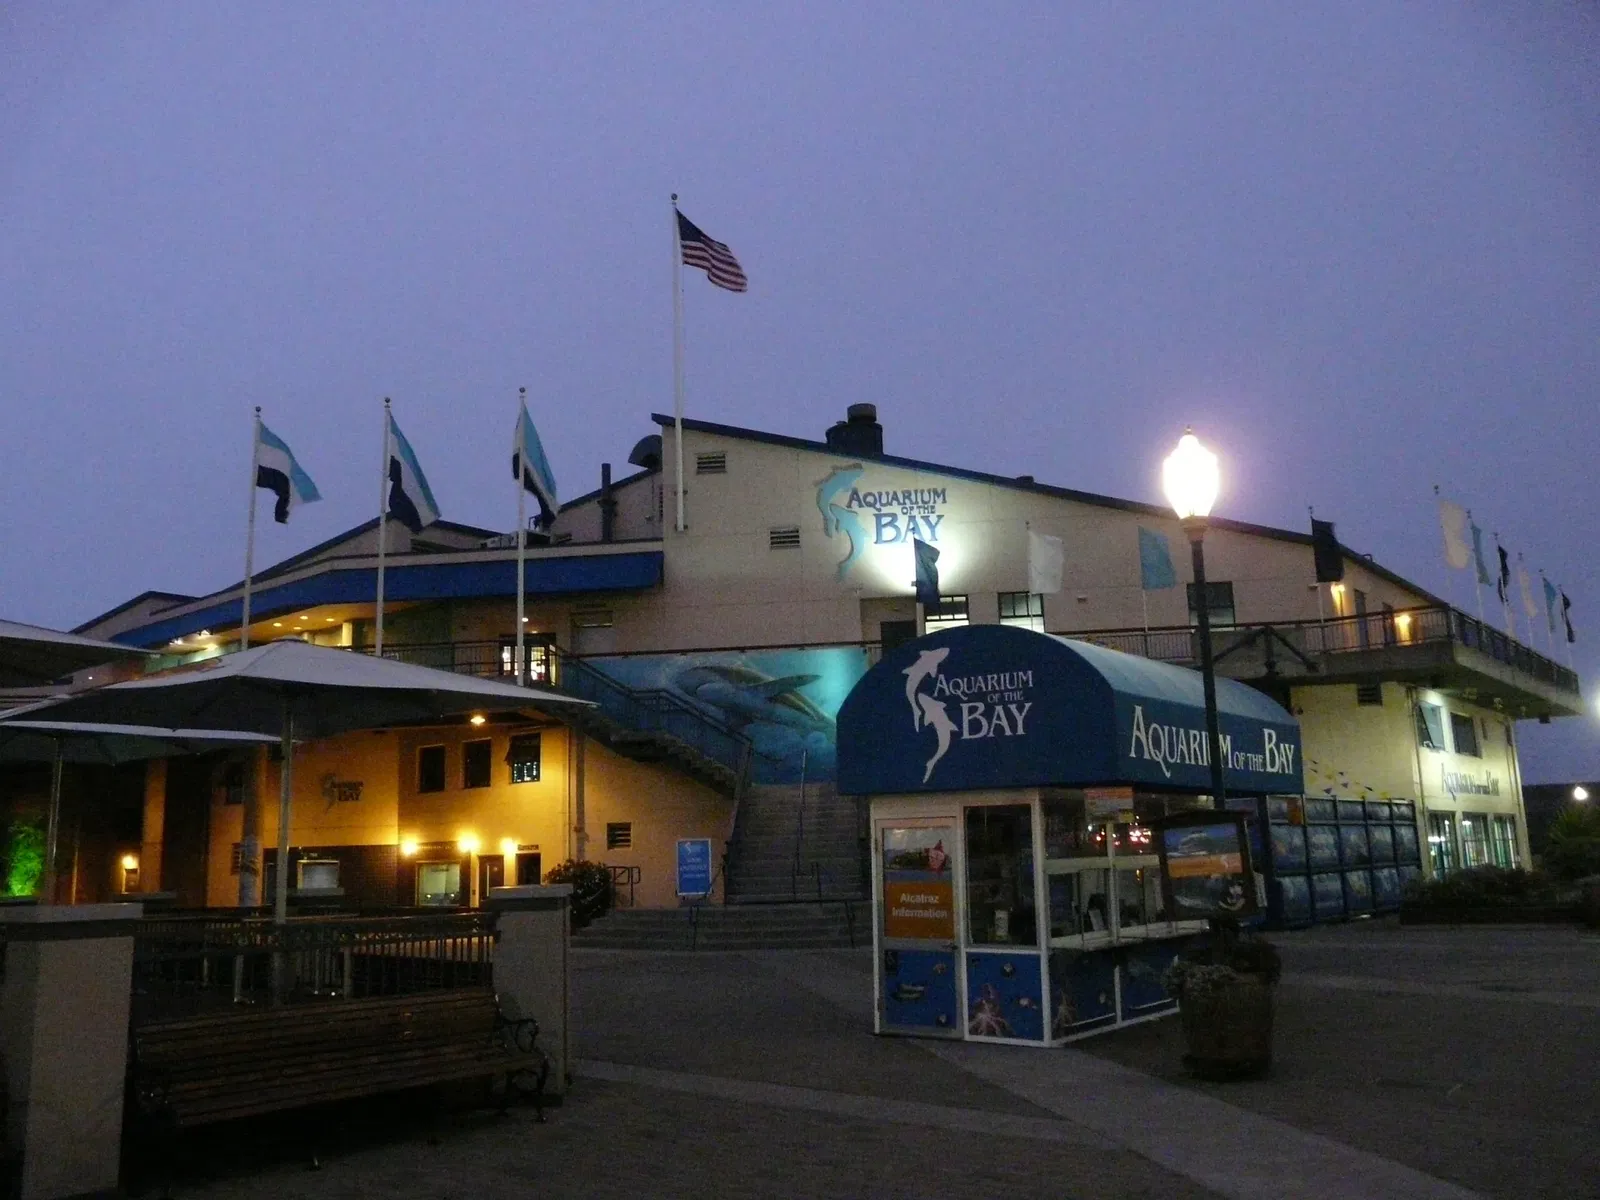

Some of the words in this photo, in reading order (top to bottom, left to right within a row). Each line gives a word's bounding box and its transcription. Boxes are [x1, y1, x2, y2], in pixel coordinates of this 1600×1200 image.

[846, 487, 947, 512] AQUARIUM
[900, 506, 914, 515] OF
[916, 505, 936, 515] THE
[873, 512, 945, 544] BAY
[932, 670, 1034, 701] AQUARIUM
[987, 693, 1001, 704] OF
[1004, 690, 1024, 702] THE
[960, 701, 1033, 740] BAY
[1233, 750, 1245, 770] OF
[1246, 752, 1265, 773] THE
[1263, 727, 1295, 774] BAY
[899, 892, 940, 904] Alcatraz
[891, 906, 948, 919] Information
